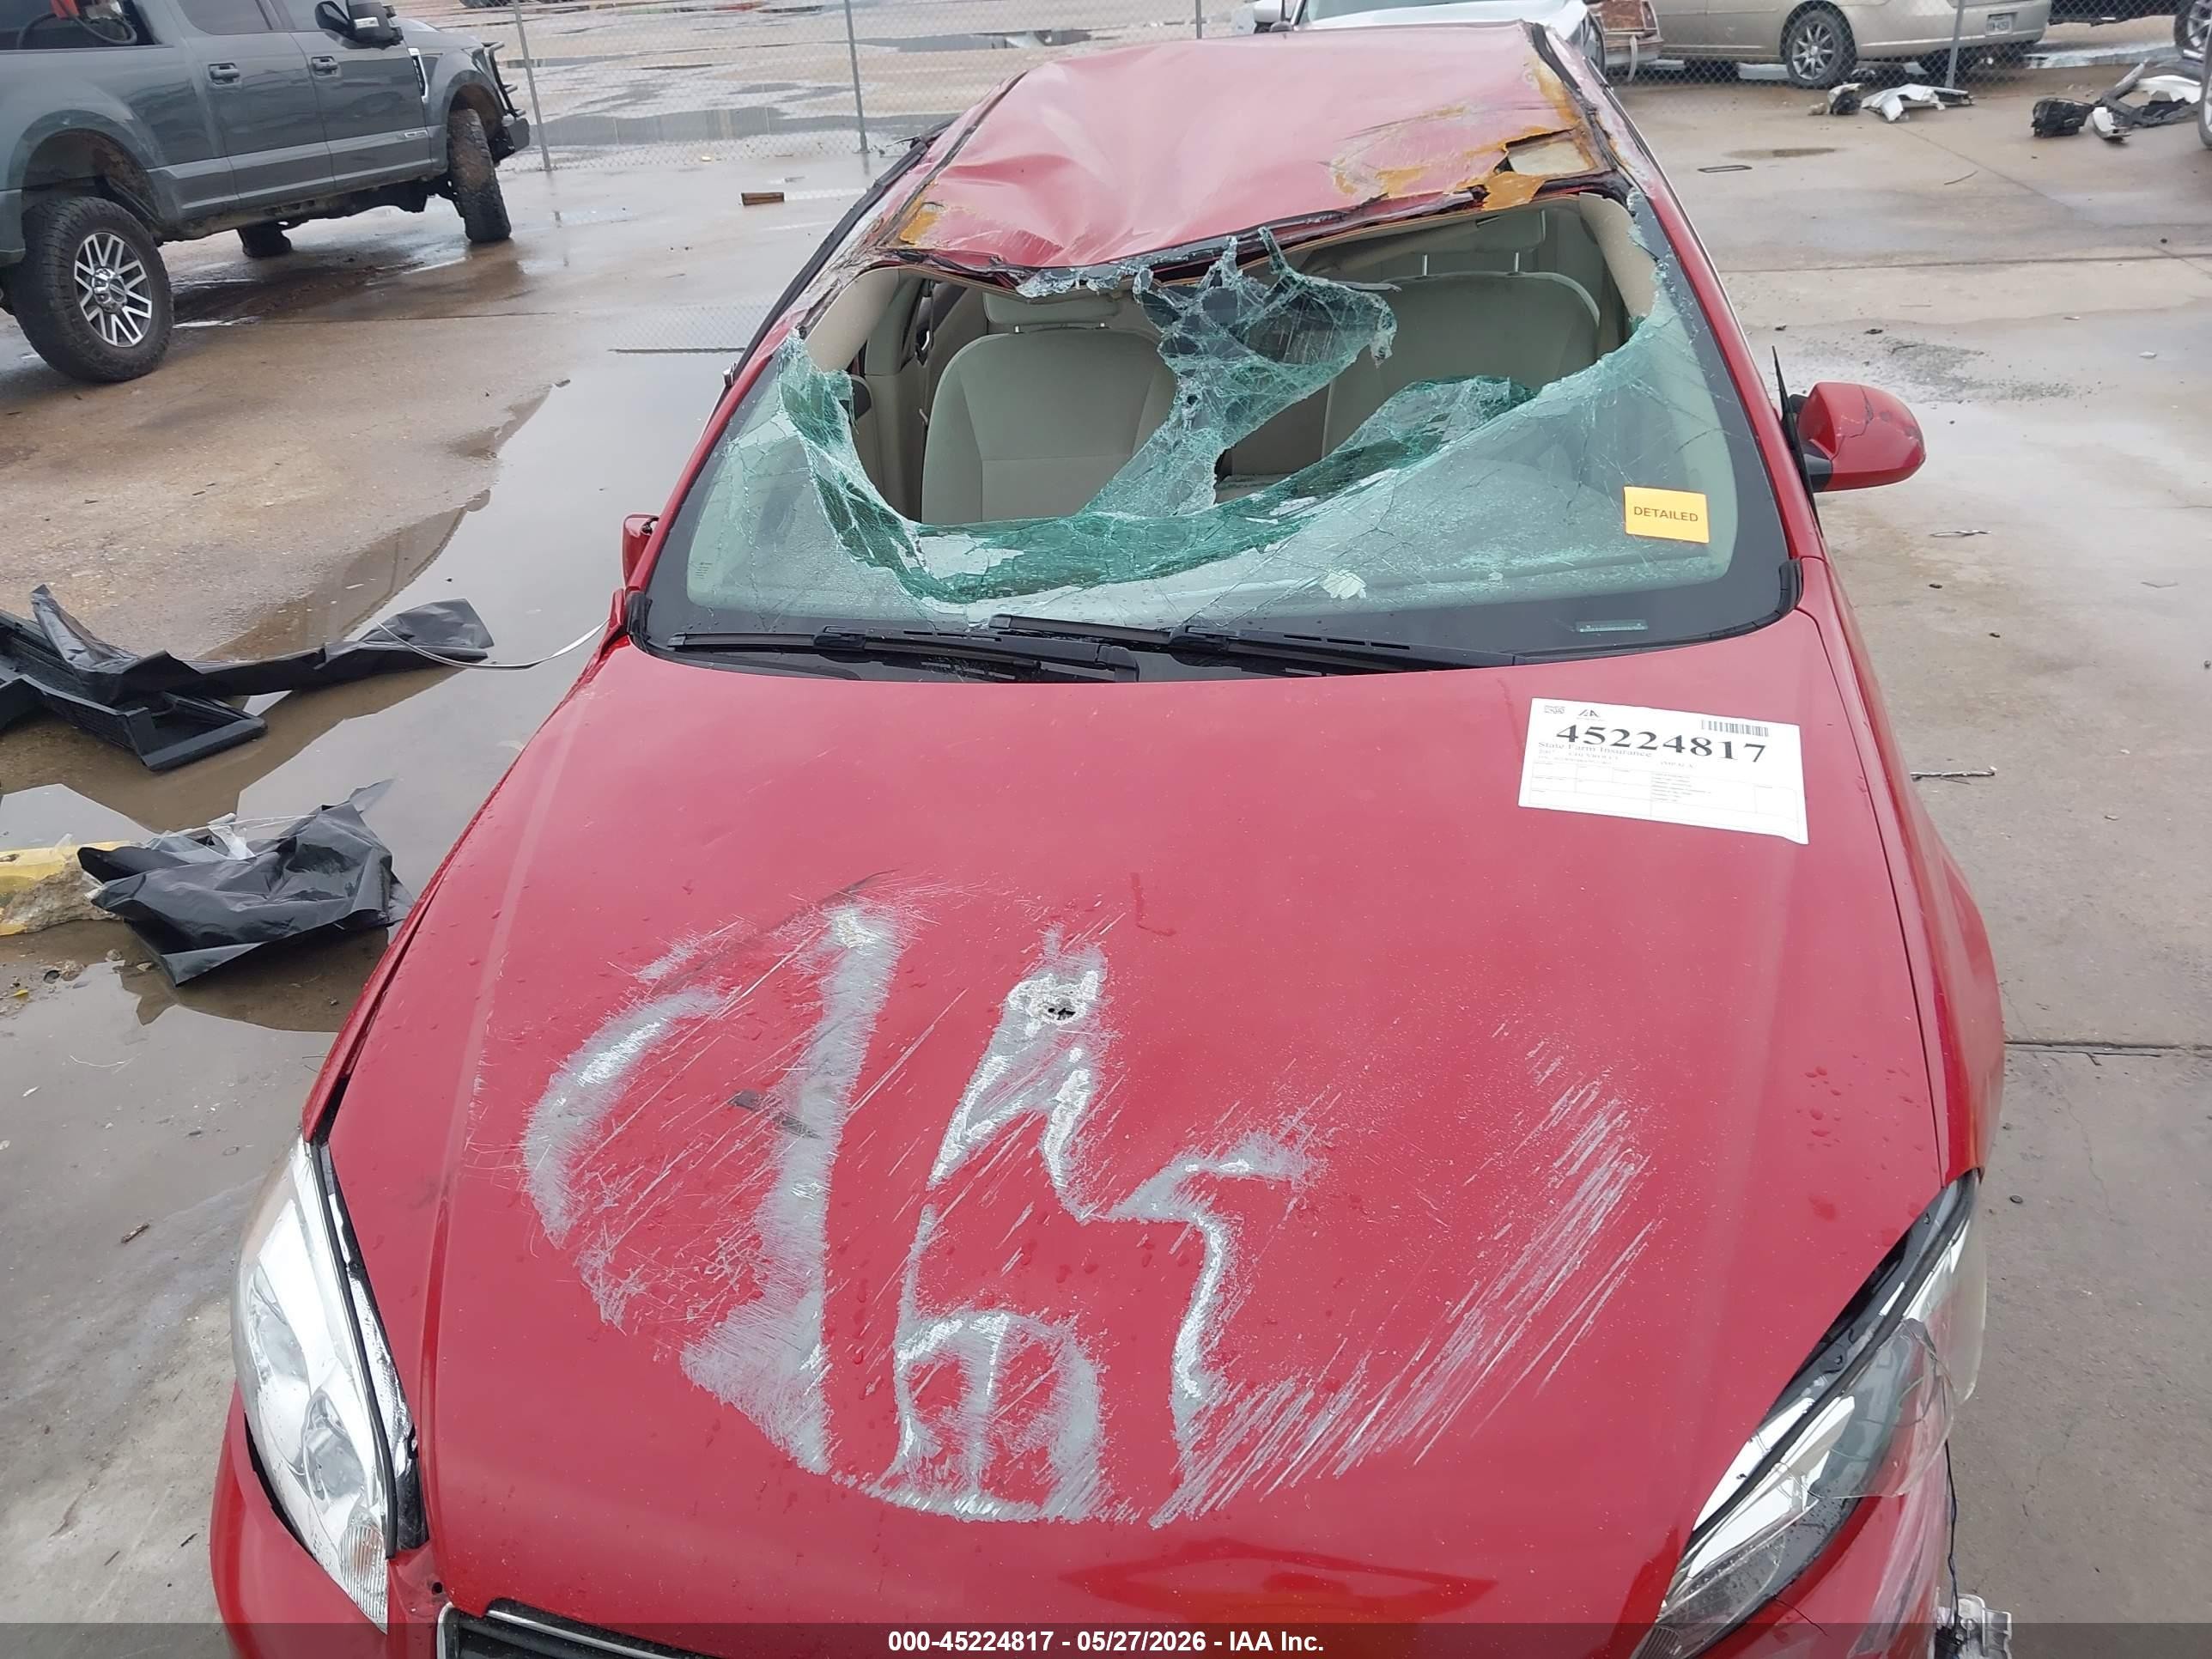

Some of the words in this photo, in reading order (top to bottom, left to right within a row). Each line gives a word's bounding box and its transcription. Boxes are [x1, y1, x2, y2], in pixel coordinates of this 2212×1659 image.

[1634, 507, 1698, 521] DETAILED
[1538, 741, 1565, 750] State
[1568, 744, 1595, 752] Farm
[1600, 746, 1653, 758] Insurance
[1555, 724, 1766, 763] 45224817
